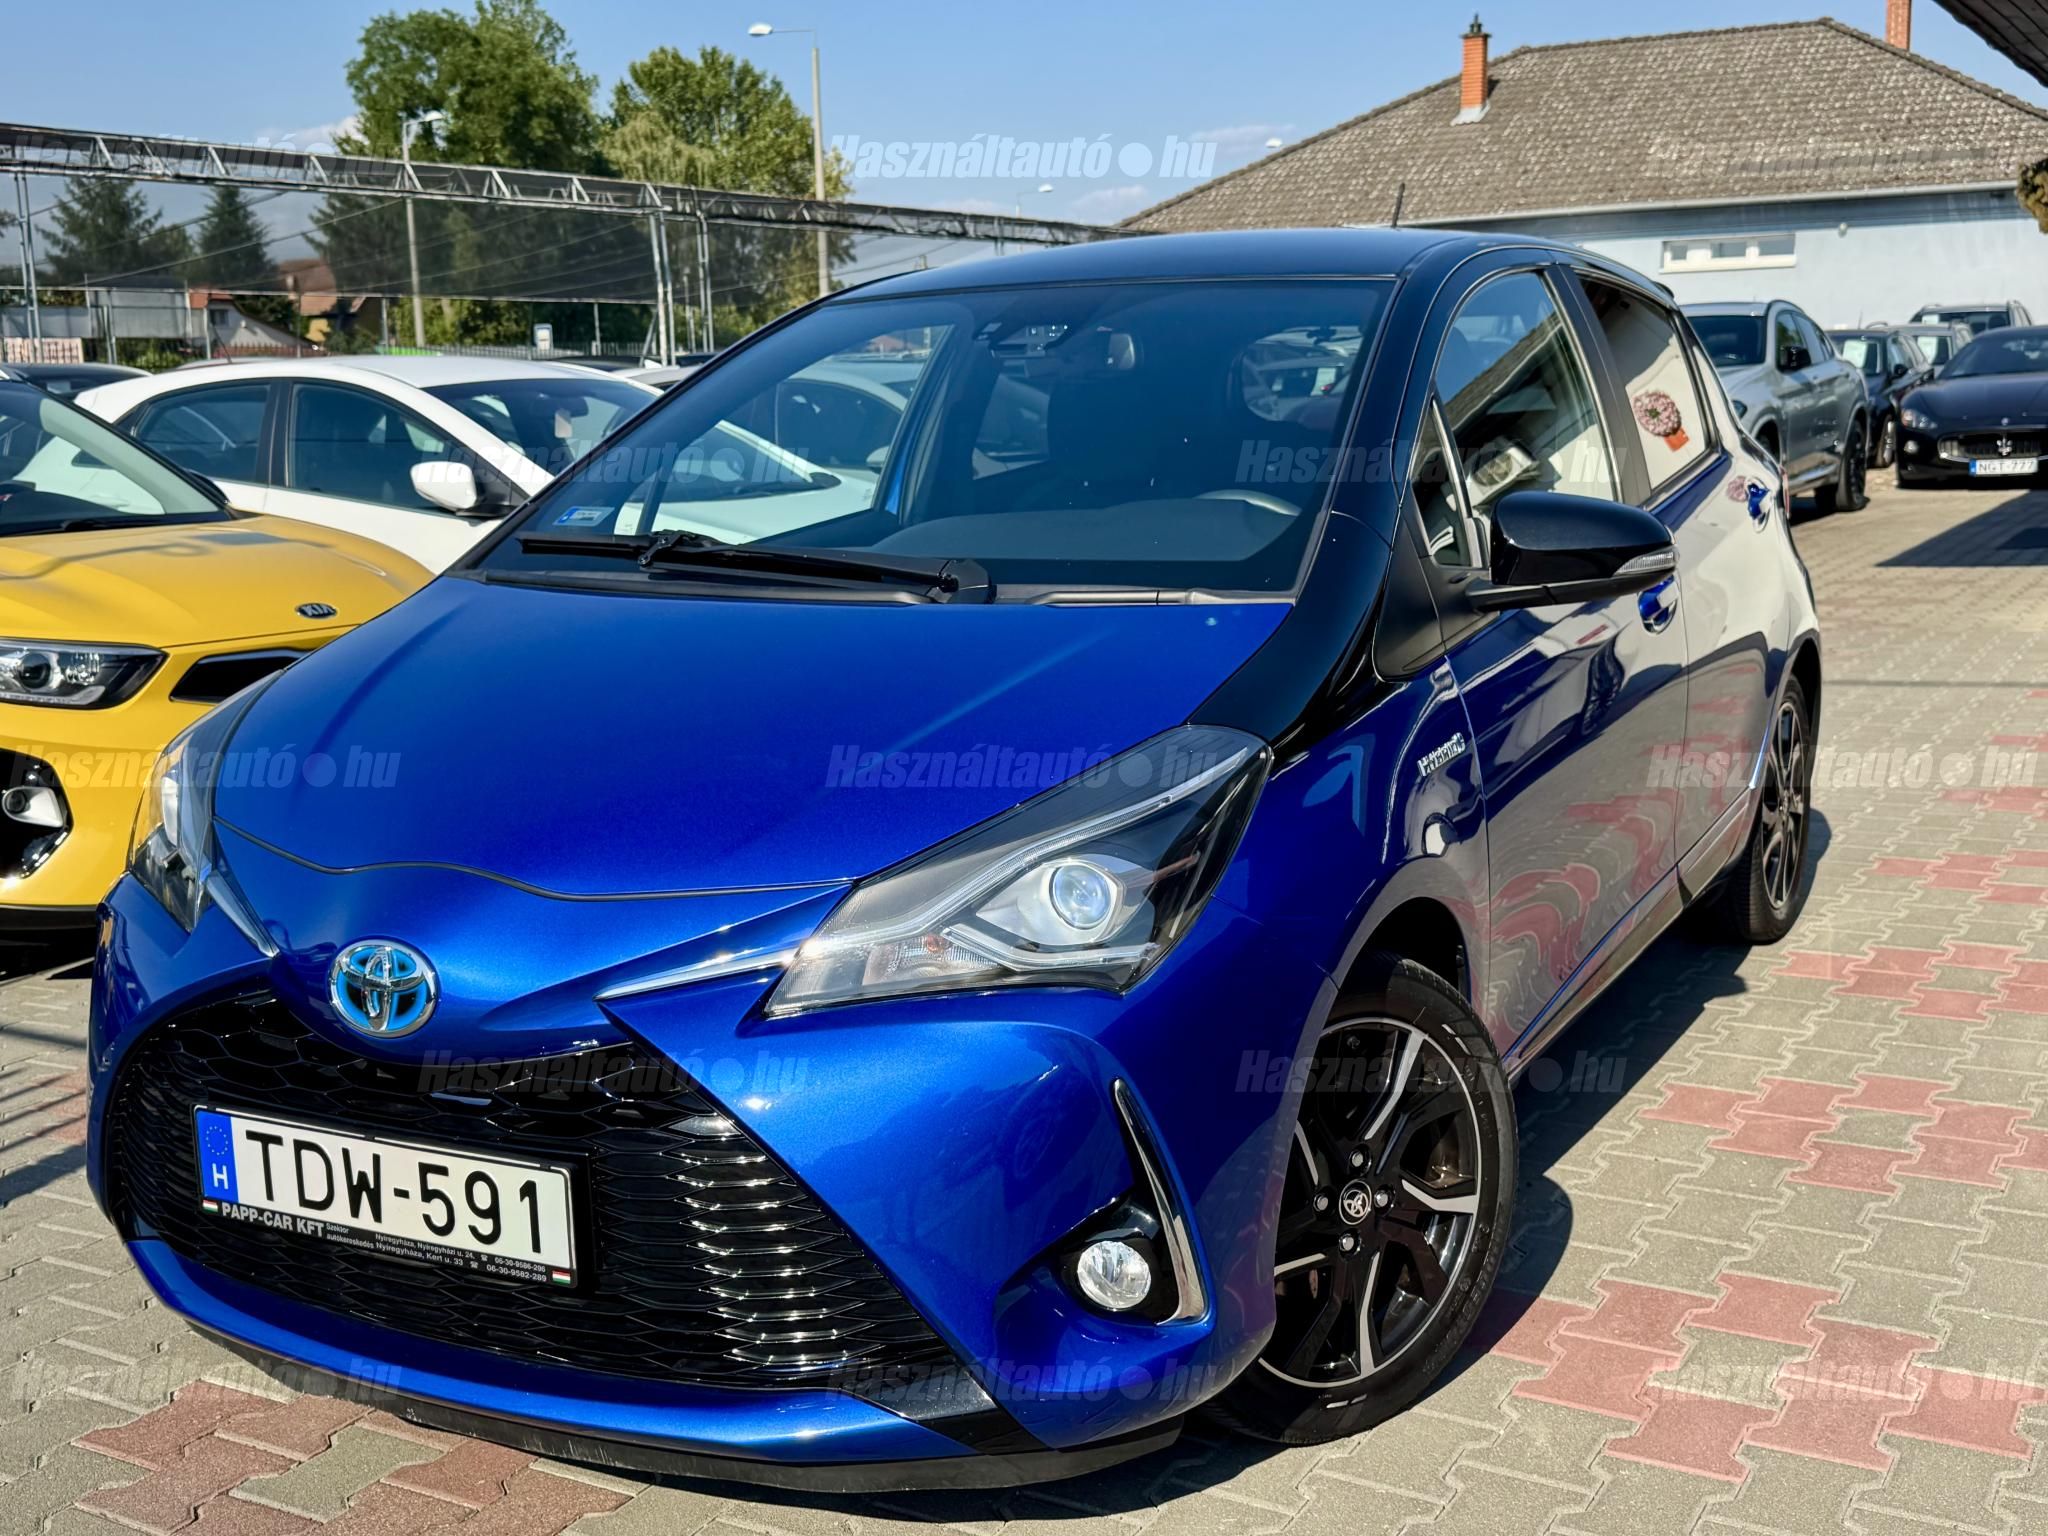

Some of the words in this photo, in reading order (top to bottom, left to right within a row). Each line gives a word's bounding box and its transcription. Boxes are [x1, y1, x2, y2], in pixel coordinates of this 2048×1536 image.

[212, 1162, 229, 1191] H
[245, 1129, 541, 1254] TDW-591
[221, 1201, 294, 1232] PAPP-CAR
[296, 1217, 325, 1238] KFT
